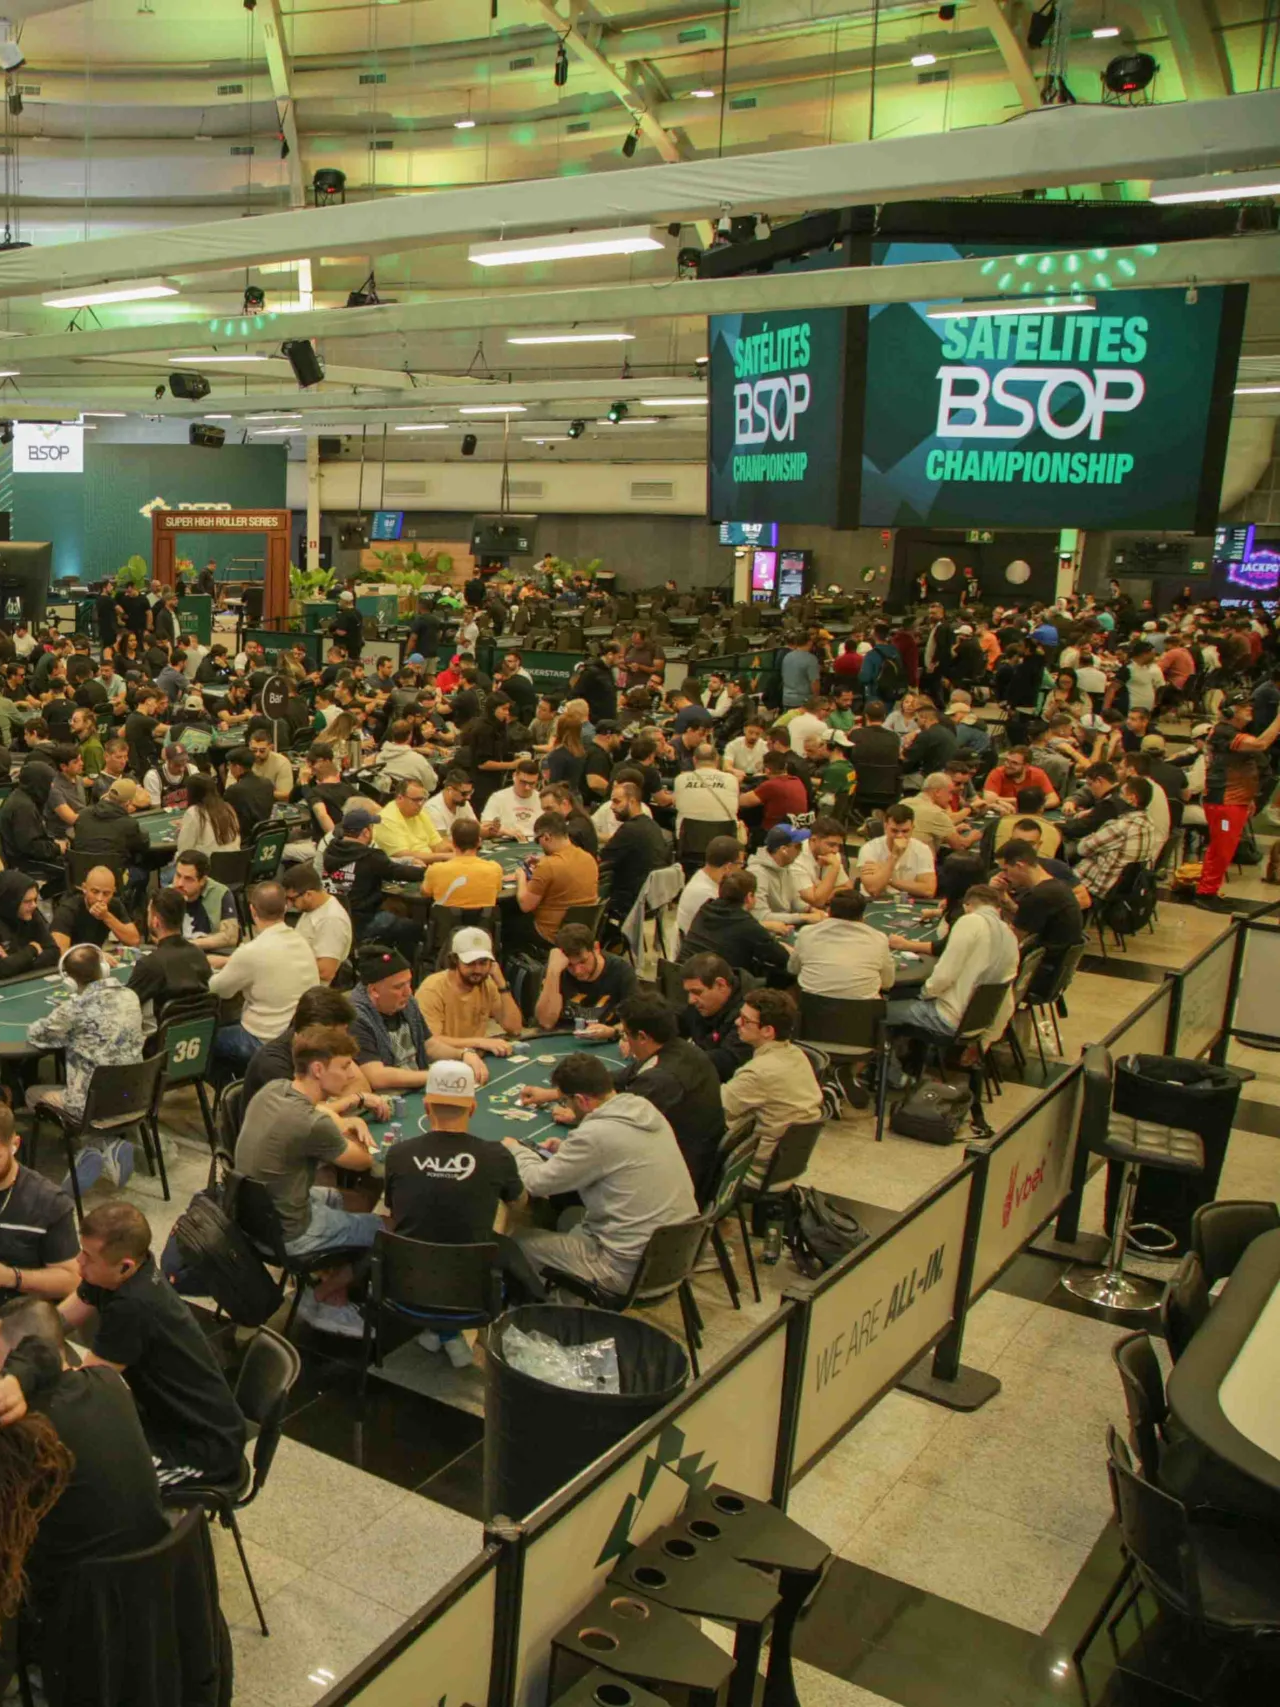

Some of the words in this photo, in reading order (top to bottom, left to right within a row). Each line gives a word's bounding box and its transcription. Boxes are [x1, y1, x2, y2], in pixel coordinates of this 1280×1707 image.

[733, 322, 811, 378] SATÉLITES
[733, 373, 811, 445] BSOP
[935, 365, 1145, 440] BSOP
[28, 445, 70, 461] BSOP
[732, 452, 808, 484] CHAMPIONSHIP
[925, 449, 1134, 484] CHAMPIONSHIP
[165, 516, 193, 527] SUPER
[194, 516, 215, 527] HIGH
[215, 516, 248, 527] ROLLER
[248, 516, 279, 527] SERIES
[1240, 563, 1279, 573] JACKPO
[525, 668, 570, 678] KERSTARS
[269, 692, 284, 704] Bar
[260, 844, 277, 861] 32
[172, 1037, 200, 1063] 36
[816, 1332, 846, 1394] WE
[845, 1299, 883, 1366] ARE
